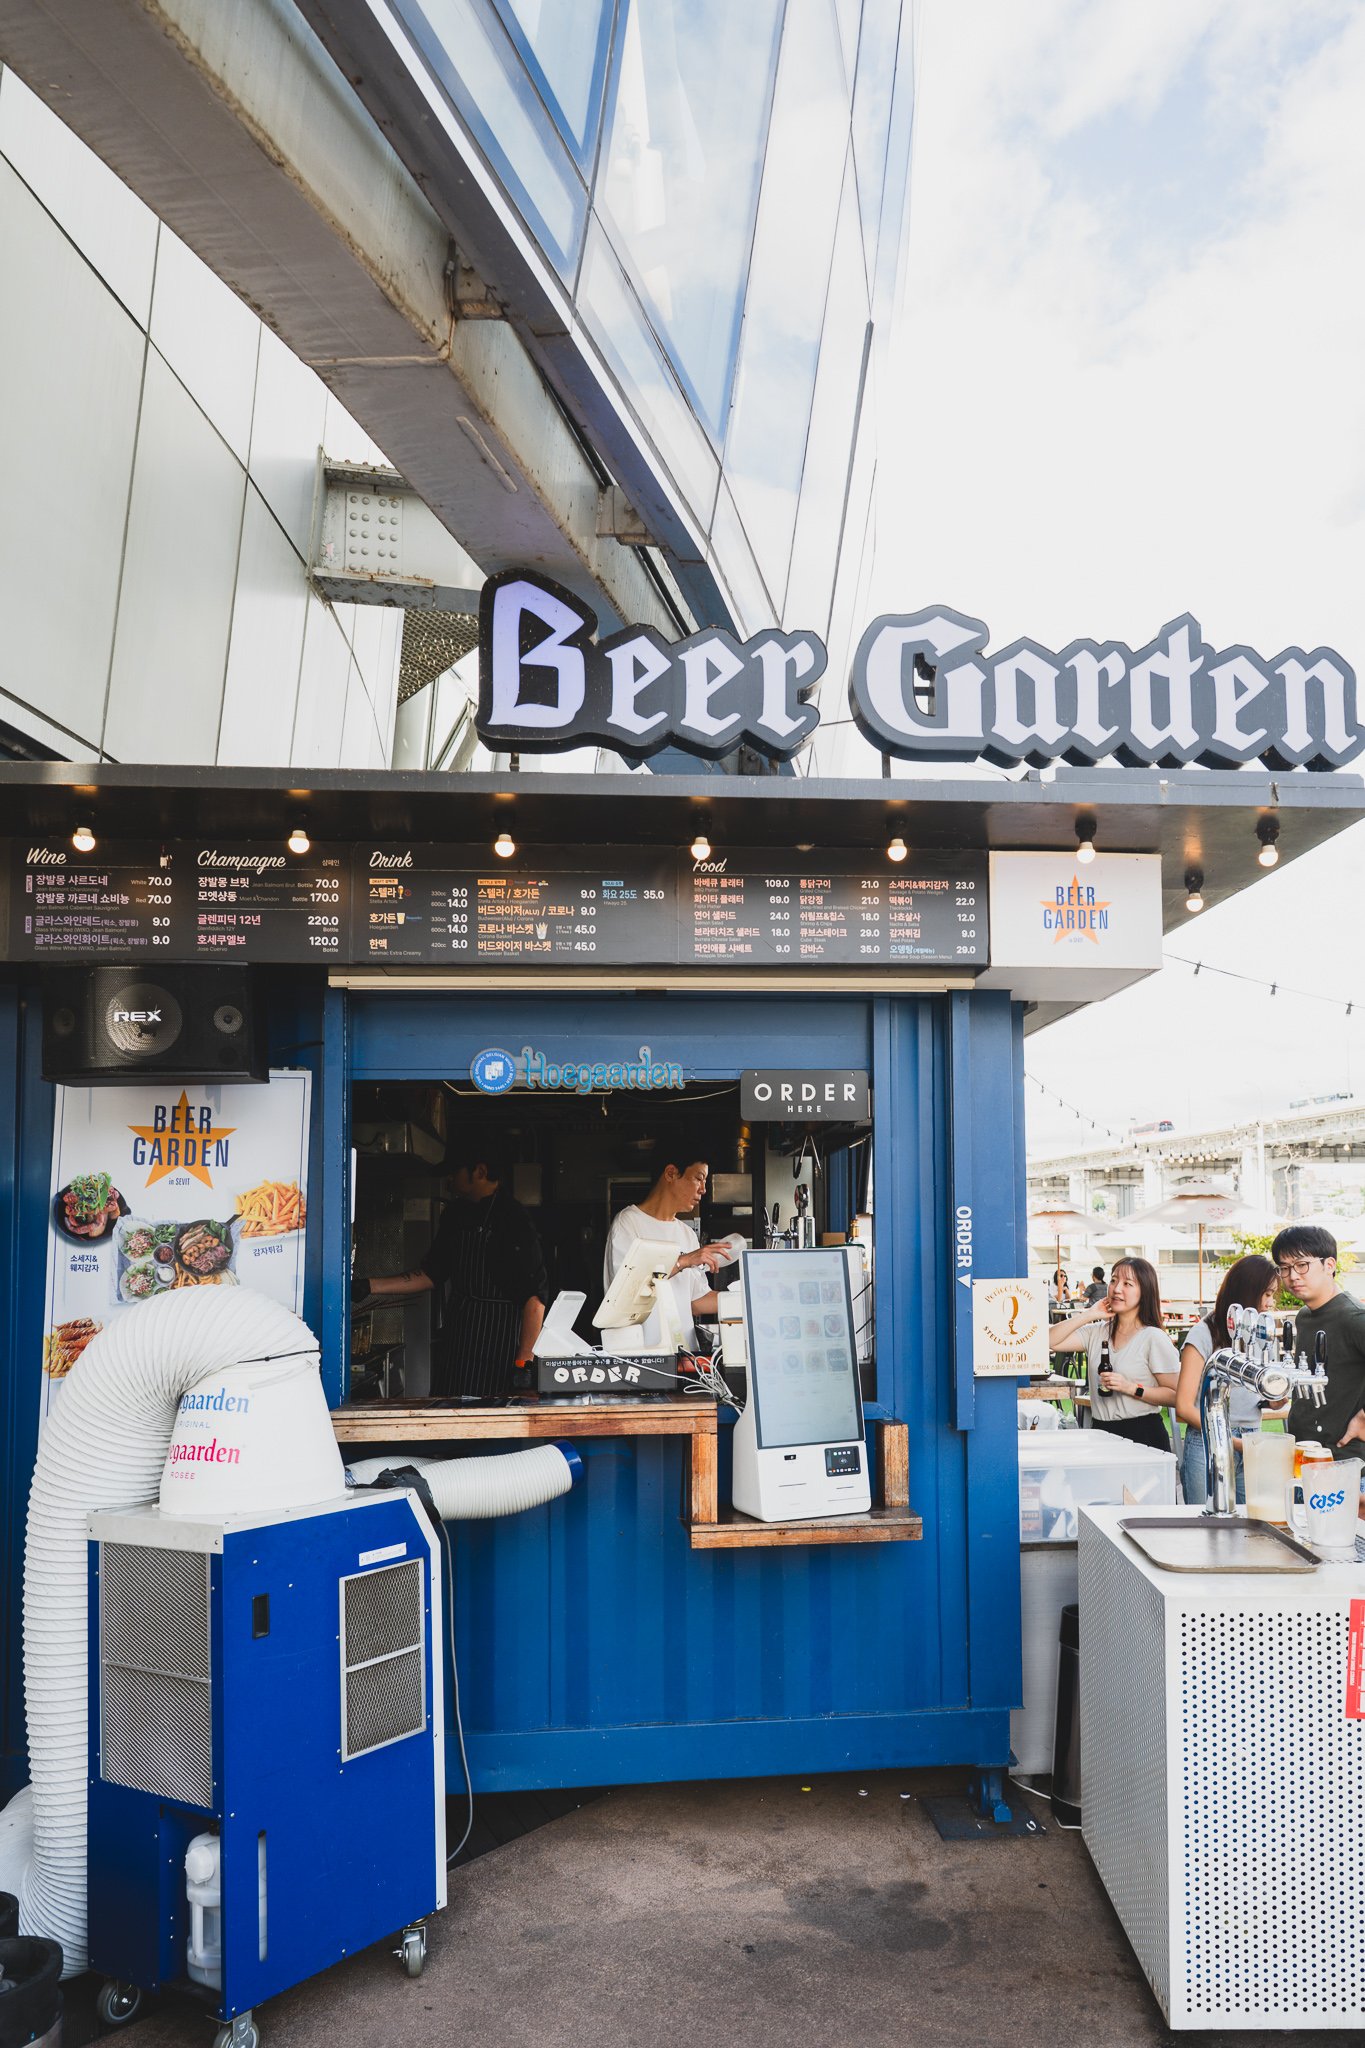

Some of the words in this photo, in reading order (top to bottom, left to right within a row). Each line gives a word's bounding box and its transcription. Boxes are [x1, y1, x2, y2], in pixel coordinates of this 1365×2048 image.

[488, 577, 817, 740] Beer
[866, 612, 1359, 755] Garden
[26, 847, 67, 865] Wine
[369, 850, 414, 868] Drink
[197, 850, 286, 875] Champagne
[693, 858, 727, 873] Food
[35, 875, 65, 886] 장발몽
[68, 875, 108, 886] 샤르도네
[148, 877, 172, 886] 70.0
[198, 877, 228, 888] 장발몽
[315, 879, 339, 889] 70.0
[765, 880, 790, 888] 109.0
[861, 880, 879, 889] 21.0
[955, 881, 975, 890] 23.0
[198, 891, 237, 902] 모엣샹동
[310, 893, 339, 903] 170.0
[369, 887, 397, 898] 스텔라
[452, 888, 468, 898] 9.0
[478, 888, 506, 899] 스텔라
[513, 888, 540, 899] 호가든
[580, 889, 597, 899] 9.0
[619, 890, 637, 899] 25도
[643, 890, 665, 899] 35.0
[1056, 886, 1095, 906] BEER
[35, 893, 65, 904] 장발몽
[68, 893, 98, 904] 까르네
[148, 895, 172, 904] 70.0
[447, 898, 468, 908] 14.0
[770, 896, 790, 904] 69.0
[861, 896, 880, 905] 21.0
[955, 898, 975, 906] 22.0
[547, 906, 575, 917] 코로나
[580, 907, 597, 916] 9.0
[694, 911, 710, 920] 연어
[770, 912, 790, 920] 24.0
[861, 913, 880, 921] 18.0
[957, 914, 976, 922] 12.0
[153, 917, 170, 927] 9.0
[239, 914, 261, 926] 12년
[308, 916, 339, 926] 220.0
[369, 912, 397, 924] 호가든
[452, 913, 468, 923] 9.0
[1043, 909, 1108, 929] GARDEN
[447, 924, 468, 934] 14.0
[478, 924, 505, 934] 코로나
[507, 924, 534, 934] 바스켓
[574, 925, 597, 934] 45.0
[771, 928, 790, 937] 18.0
[860, 929, 880, 937] 29.0
[889, 928, 921, 938] 감자튀김
[961, 930, 976, 938] 9.0
[152, 935, 170, 945] 9.0
[308, 936, 339, 946] 120.0
[369, 938, 388, 950] 한맥
[451, 939, 468, 949] 8.0
[478, 941, 522, 952] 버드와이저
[525, 941, 552, 952] 바스켓
[574, 942, 597, 951] 45.0
[776, 945, 790, 953] 9.0
[800, 944, 824, 954] 감바스
[860, 945, 880, 953] 35.0
[956, 946, 976, 954] 29.0
[113, 1010, 162, 1022] REX
[523, 1052, 684, 1093] Hoegaarden
[754, 1083, 856, 1102] ORDER
[153, 1105, 212, 1134] BEER
[132, 1137, 229, 1167] GARDEN
[176, 1178, 190, 1186] SEVIT
[956, 1206, 972, 1268] ORDER
[253, 1245, 283, 1257] 감자튀김
[70, 1254, 98, 1264] 소세지&
[70, 1263, 99, 1273] 웨지감자
[984, 1326, 1007, 1346] STELLA
[1015, 1324, 1038, 1345] ARTOIS
[997, 1352, 1013, 1363] TOP
[1016, 1352, 1027, 1362] 50
[554, 1366, 640, 1383] ORDER
